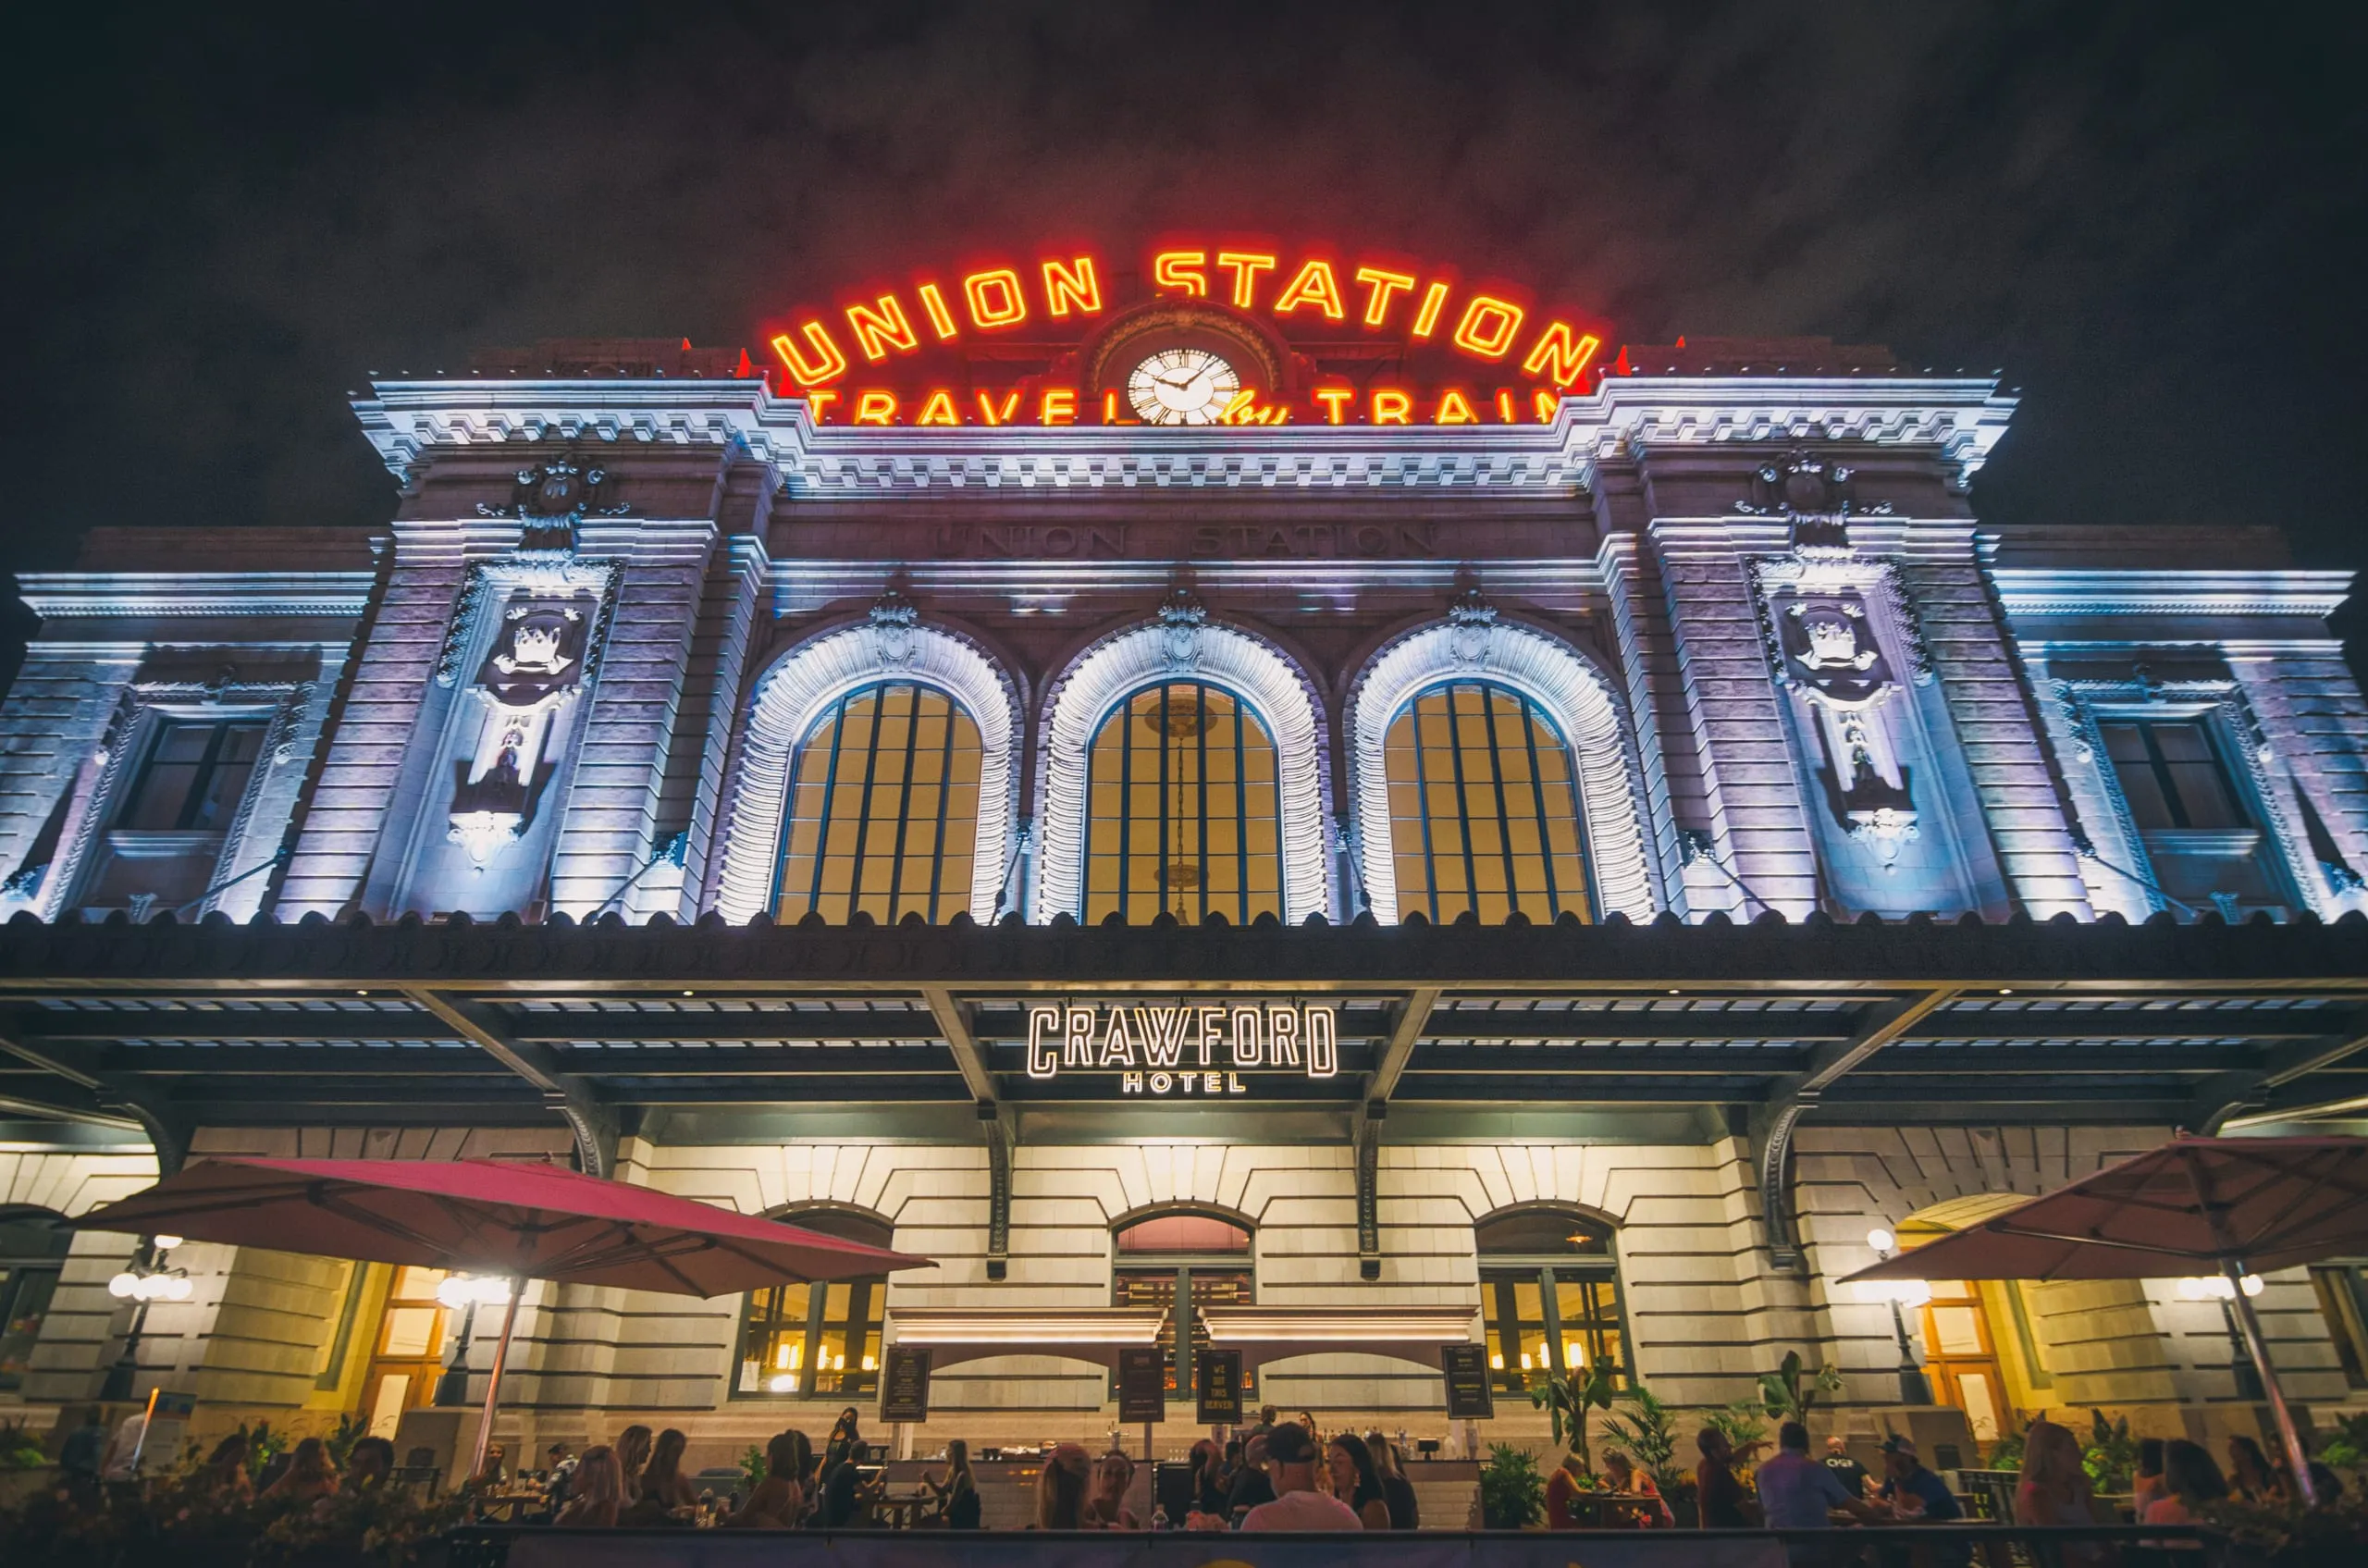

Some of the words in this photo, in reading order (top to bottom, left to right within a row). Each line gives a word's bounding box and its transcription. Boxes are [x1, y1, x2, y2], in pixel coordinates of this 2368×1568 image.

[771, 258, 1103, 387] UNION
[1155, 252, 1600, 387] STATION
[808, 389, 1141, 425] TRAVEL
[932, 525, 1127, 555] UNION
[1190, 525, 1437, 555] STATION
[1027, 1006, 1338, 1079] CRAWFORD
[1122, 1071, 1247, 1093] HOTEL
